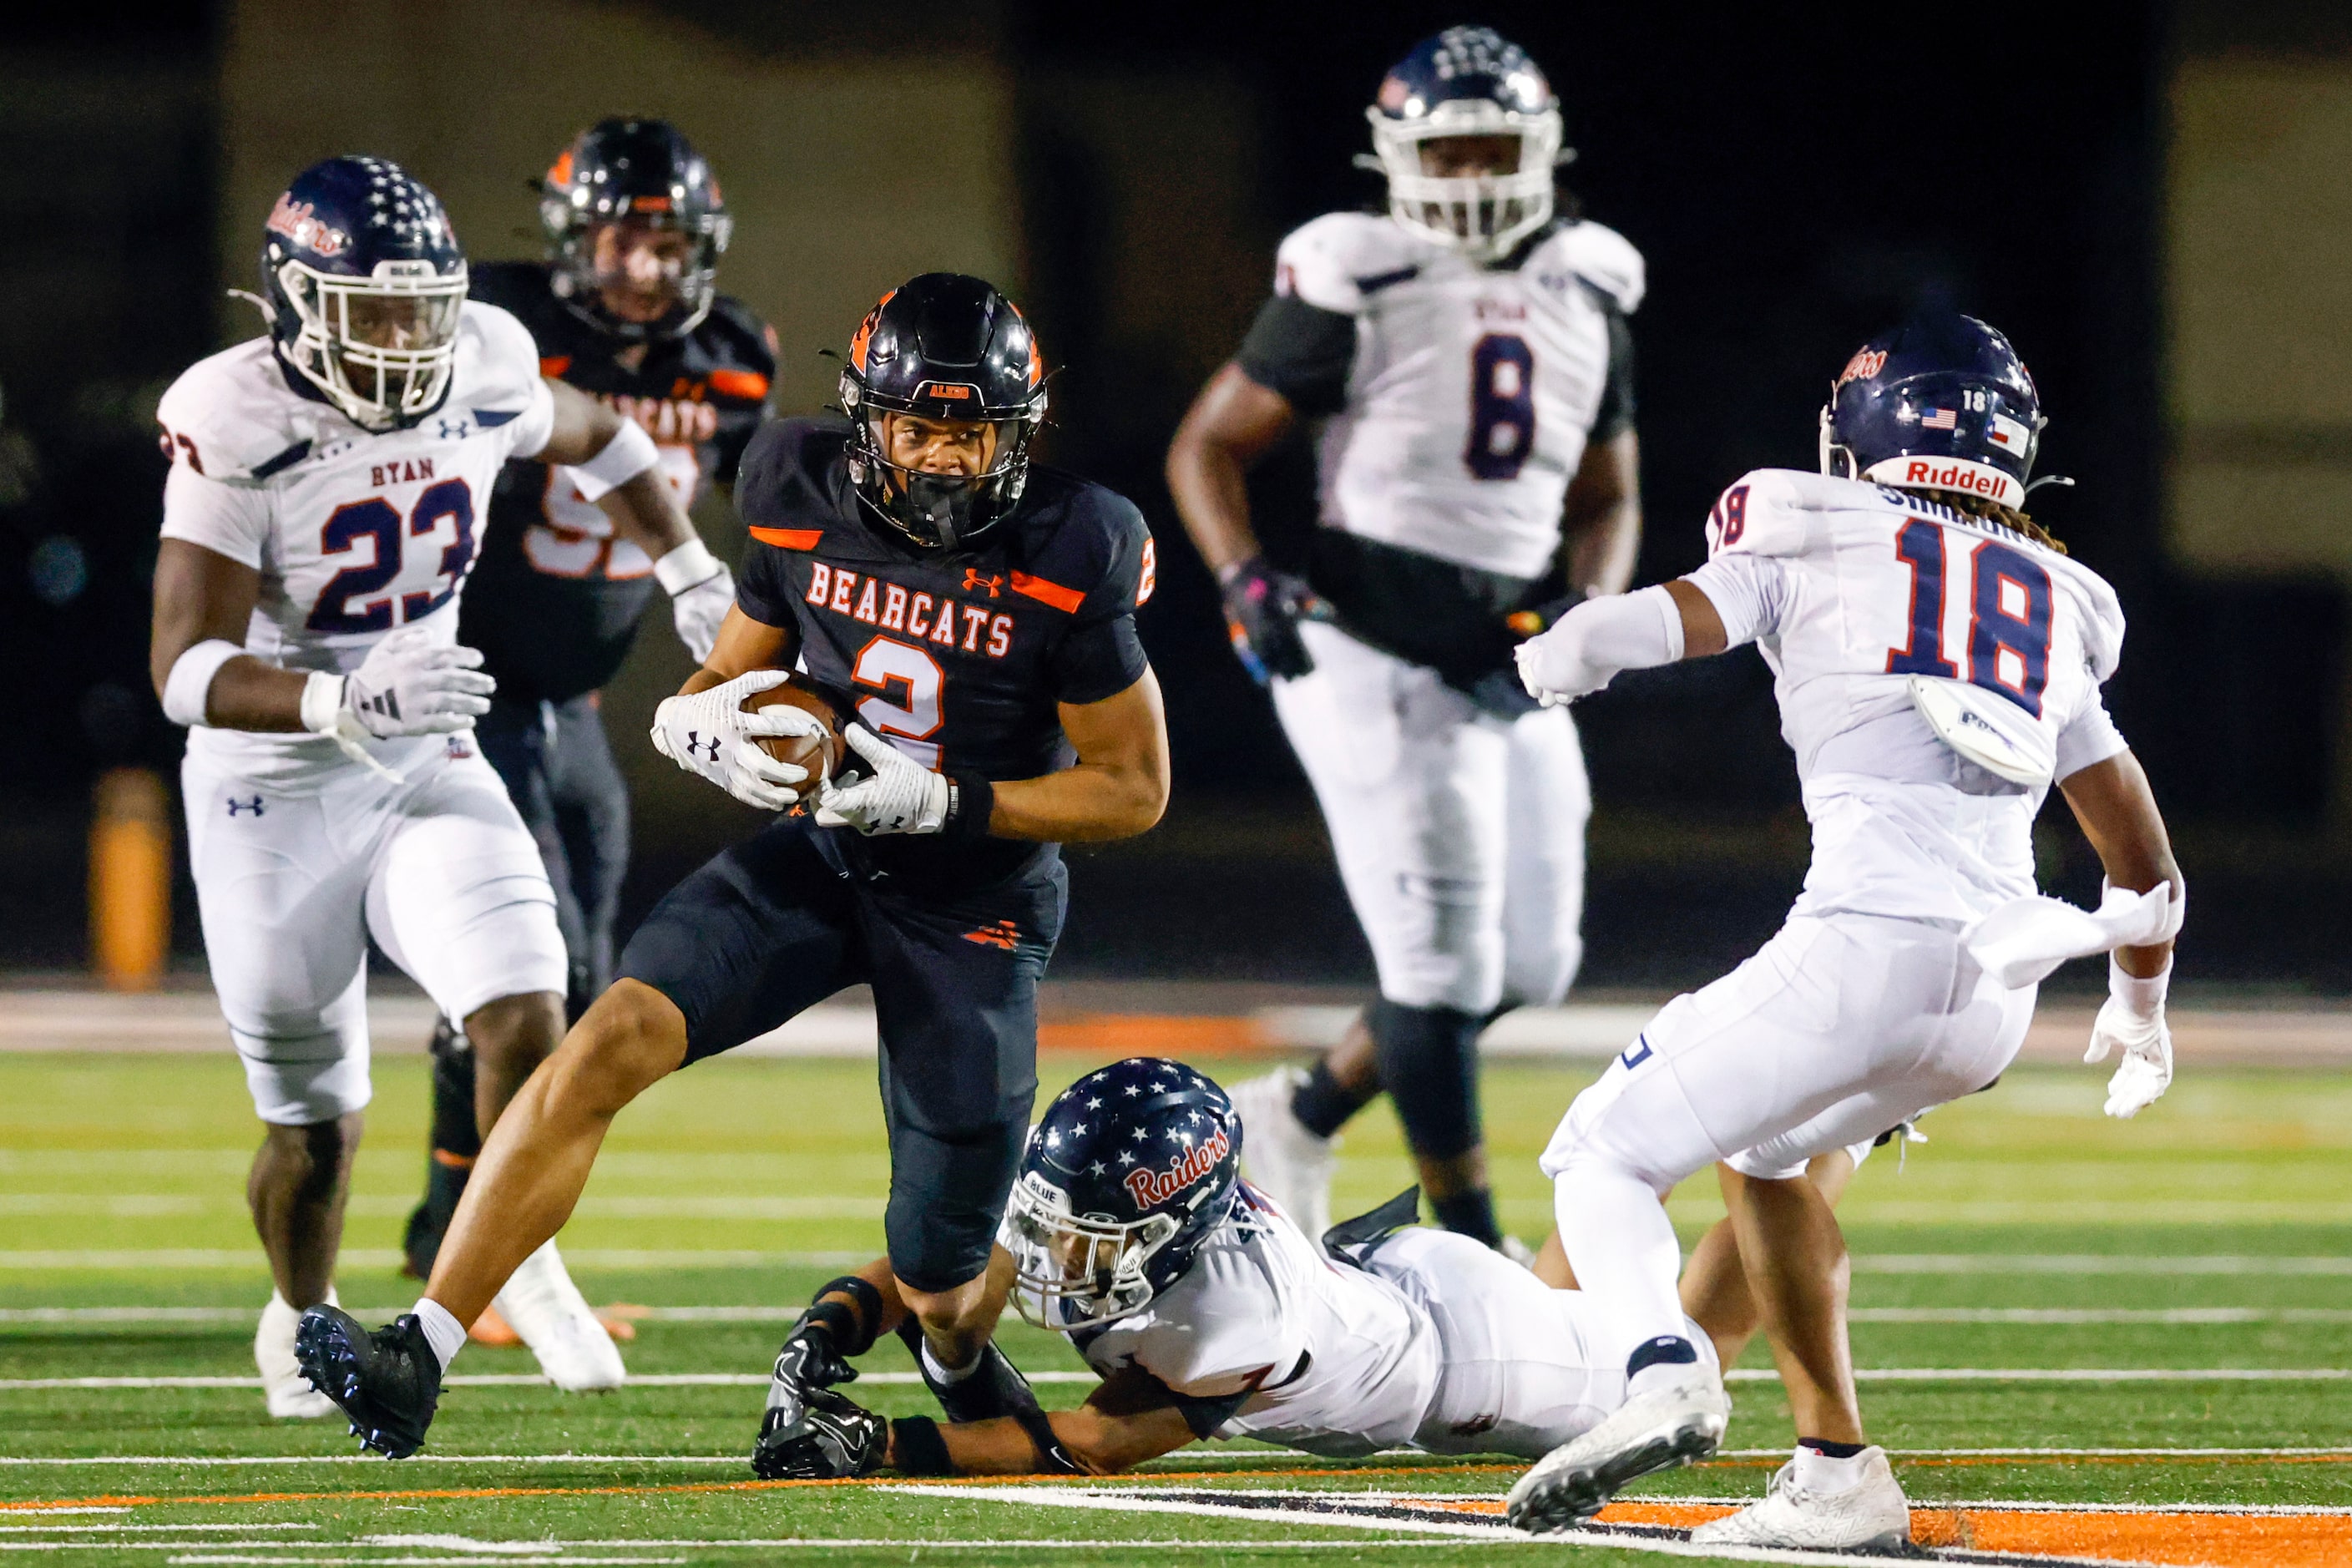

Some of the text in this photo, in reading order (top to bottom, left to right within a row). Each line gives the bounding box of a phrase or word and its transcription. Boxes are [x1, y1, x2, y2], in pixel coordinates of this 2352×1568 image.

[1464, 331, 1535, 481] 8
[1962, 388, 1987, 413] 18
[371, 458, 435, 488] RYAN
[1905, 460, 2008, 499] Riddell
[306, 476, 475, 632] 23
[1710, 484, 1751, 554] 18
[805, 560, 1014, 658] BEARCATS
[1135, 537, 1157, 607] 2
[1885, 515, 2053, 721] 18
[850, 633, 946, 775] 2
[1029, 1179, 1057, 1204] BLUE
[1123, 1127, 1230, 1211] Raiders
